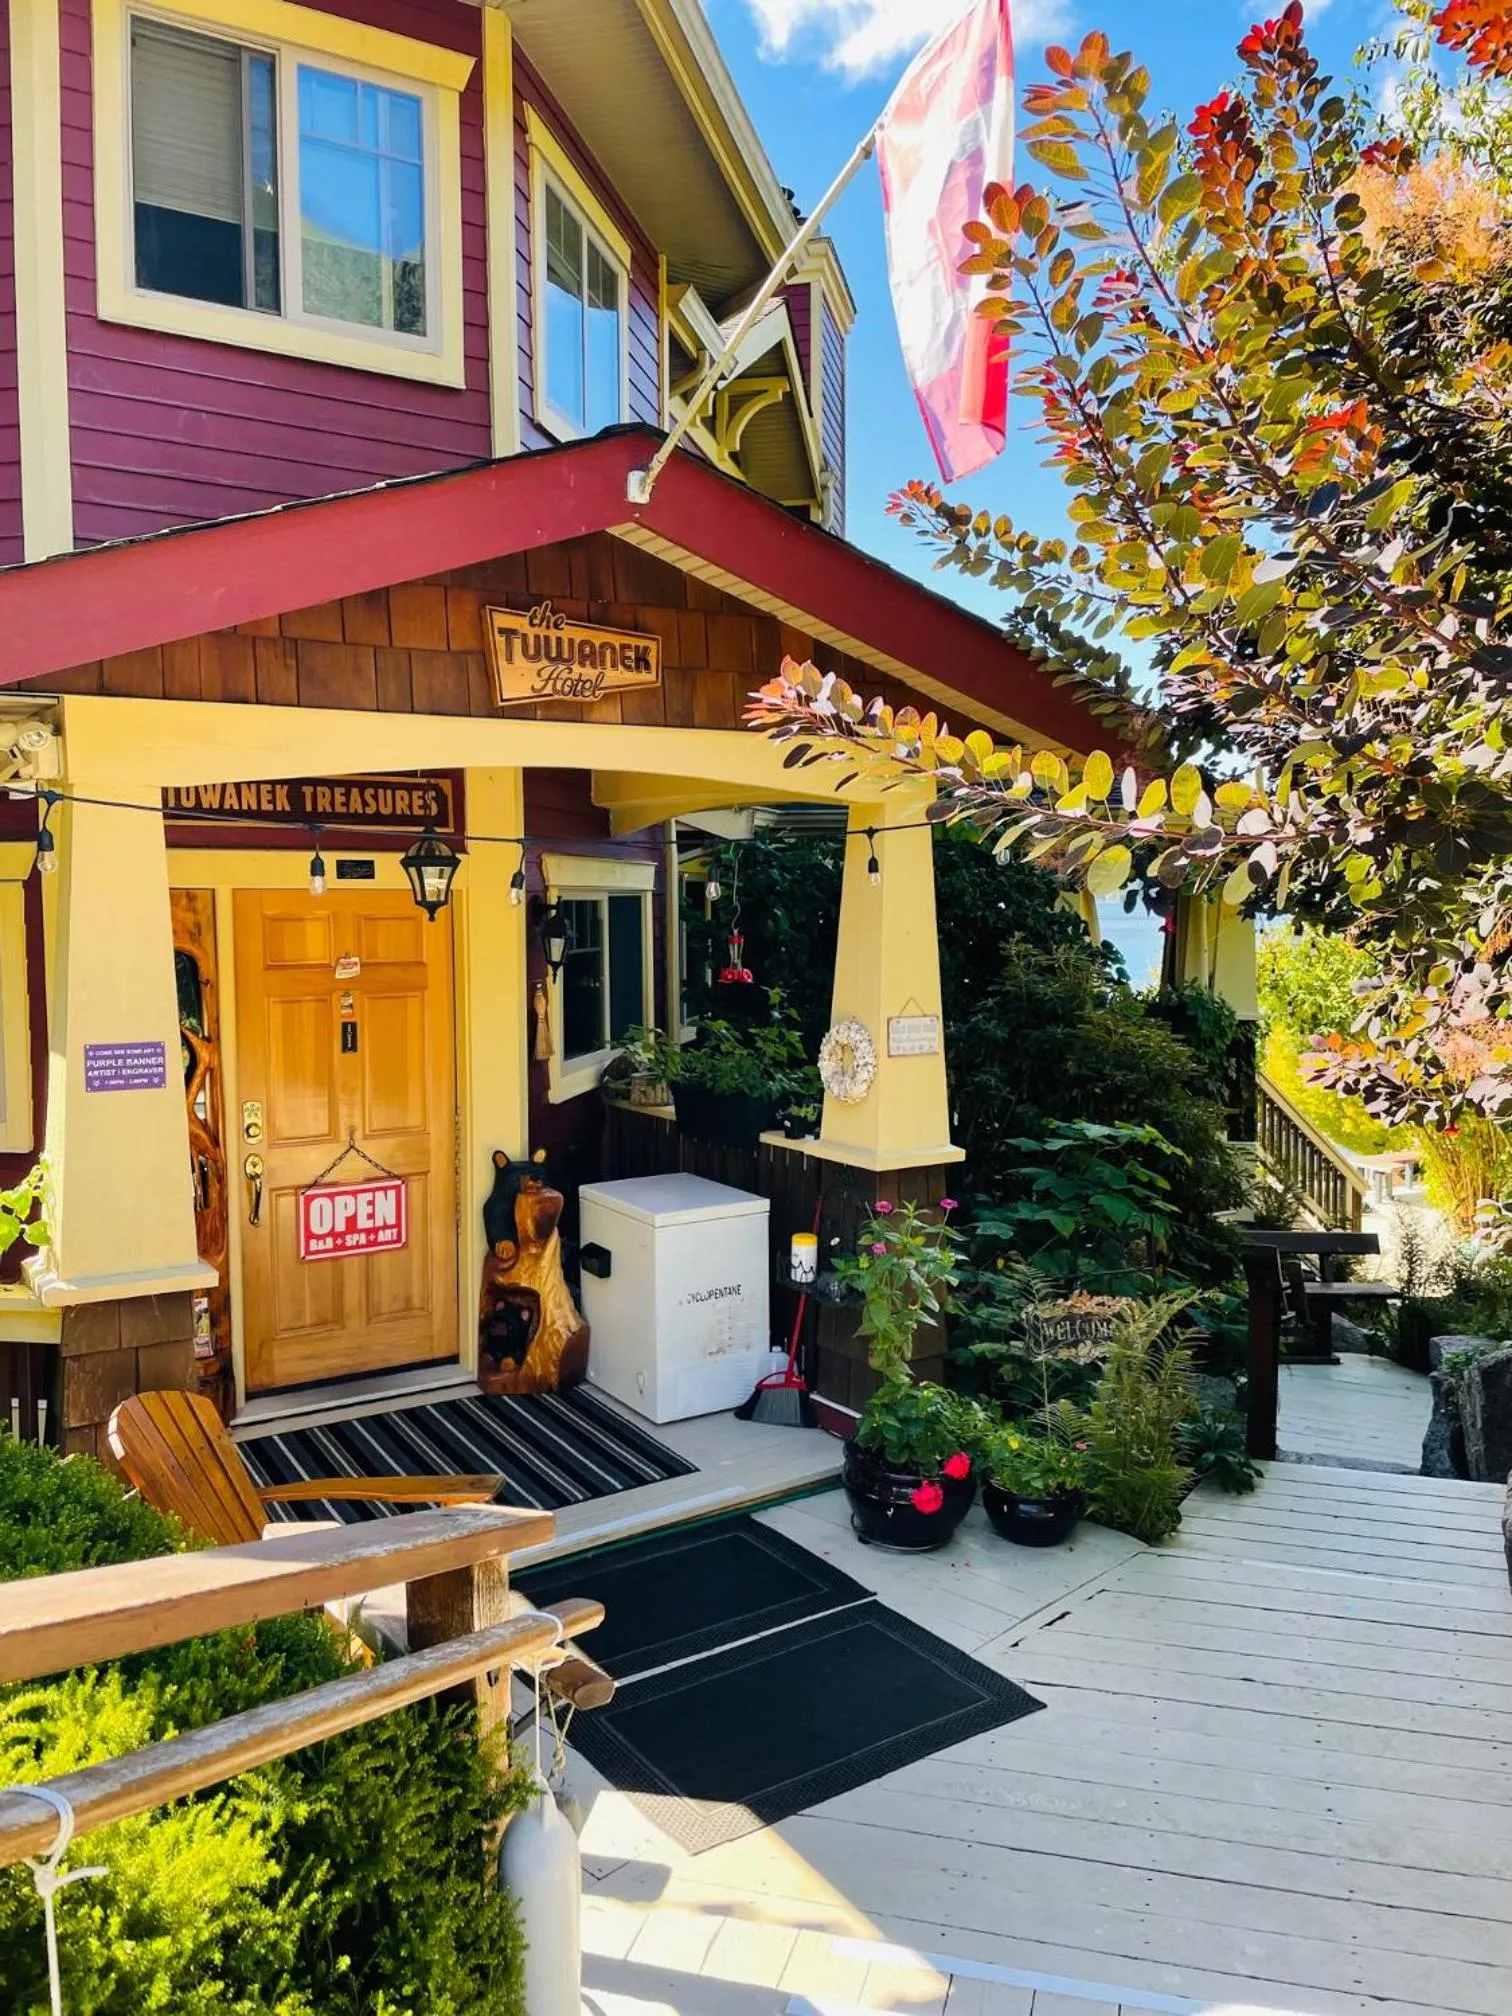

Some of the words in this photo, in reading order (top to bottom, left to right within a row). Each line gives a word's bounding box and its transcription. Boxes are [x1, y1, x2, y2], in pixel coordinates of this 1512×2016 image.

[528, 601, 566, 631] the
[497, 627, 652, 674] TUWANEK
[531, 666, 605, 699] Hotel
[167, 783, 291, 811] TUWANEK
[302, 785, 439, 817] TREASURES
[86, 1059, 125, 1068] PURPLE
[126, 1057, 164, 1066] BANNER
[88, 1069, 116, 1077] ARTIST
[122, 1067, 164, 1075] ENGRAVER
[310, 1190, 396, 1235] OPEN
[310, 1237, 334, 1251] B&B
[345, 1233, 367, 1247] SPA
[377, 1228, 398, 1243] ART
